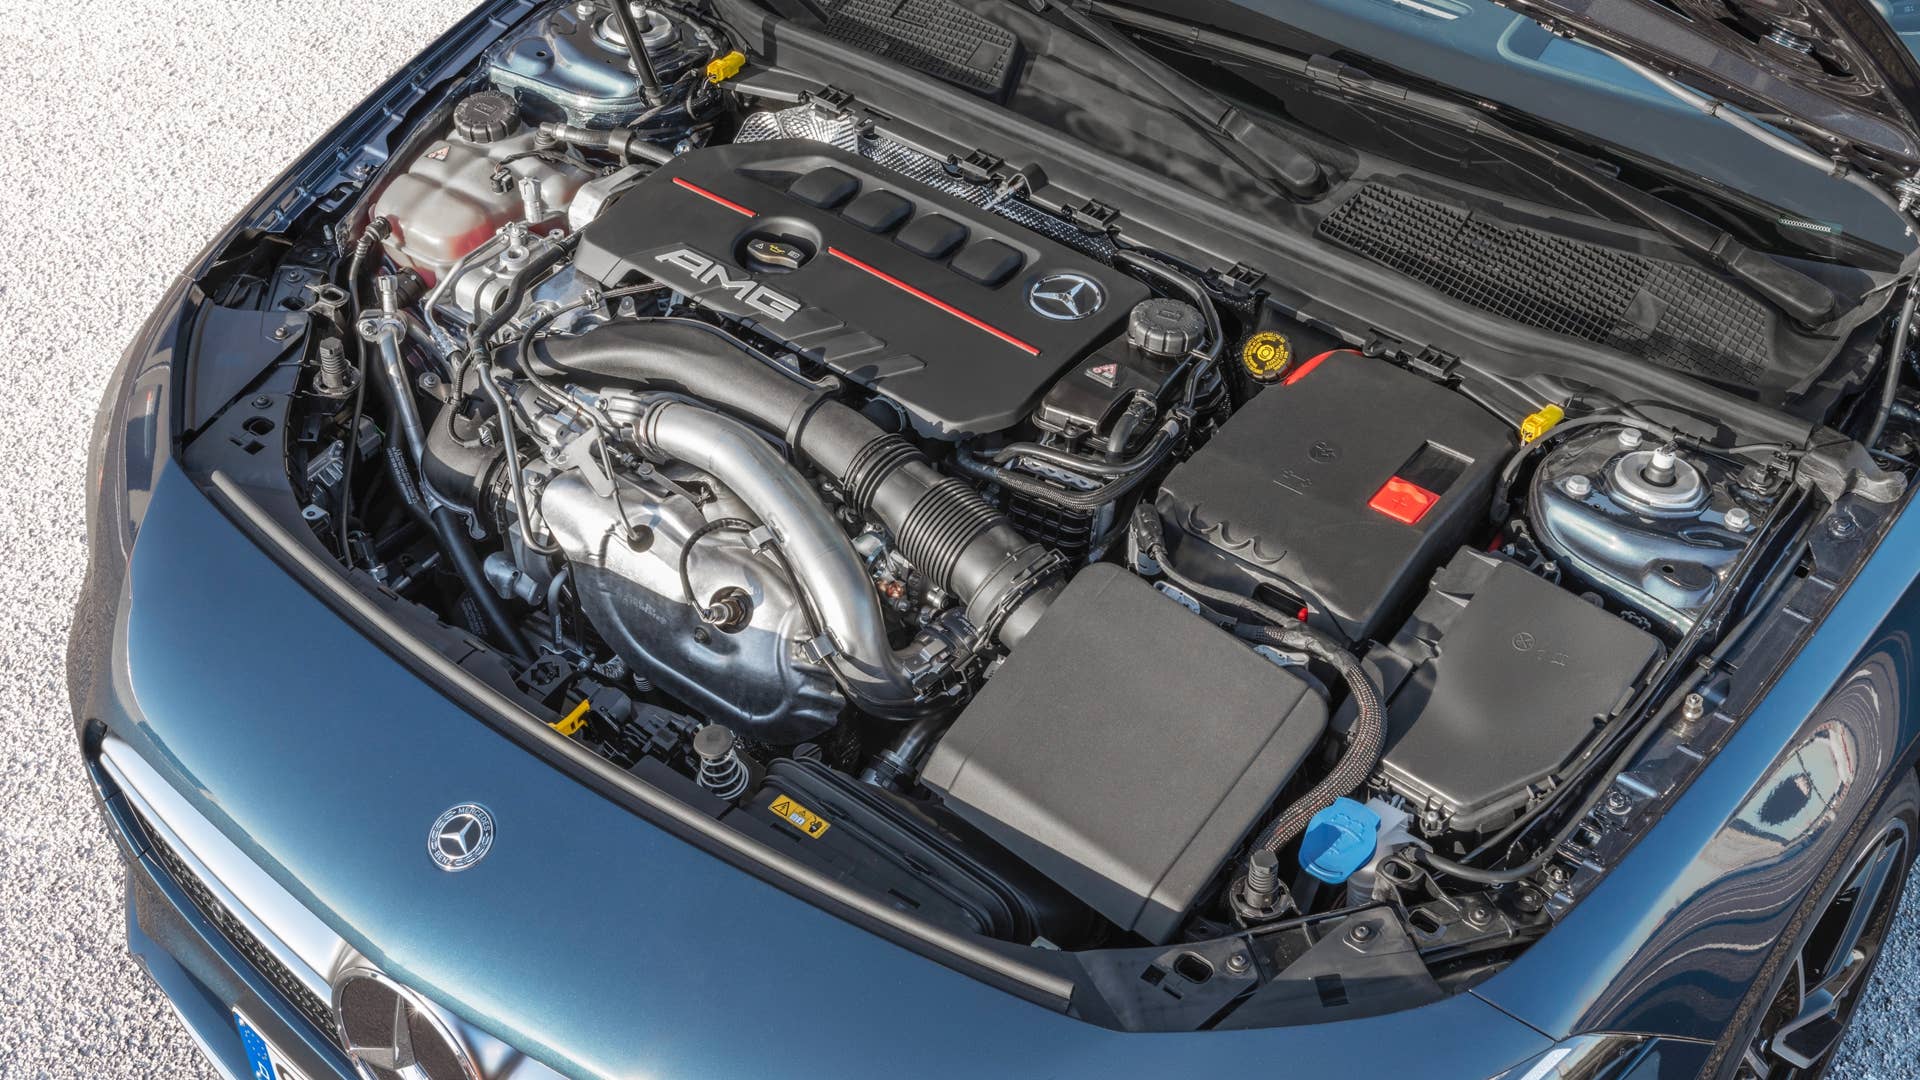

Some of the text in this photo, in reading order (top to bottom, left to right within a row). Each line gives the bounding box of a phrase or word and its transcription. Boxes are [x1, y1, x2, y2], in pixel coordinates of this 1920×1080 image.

[655, 249, 801, 322] AMG
[458, 807, 490, 831] MERCEDES
[434, 850, 452, 866] BENZ
